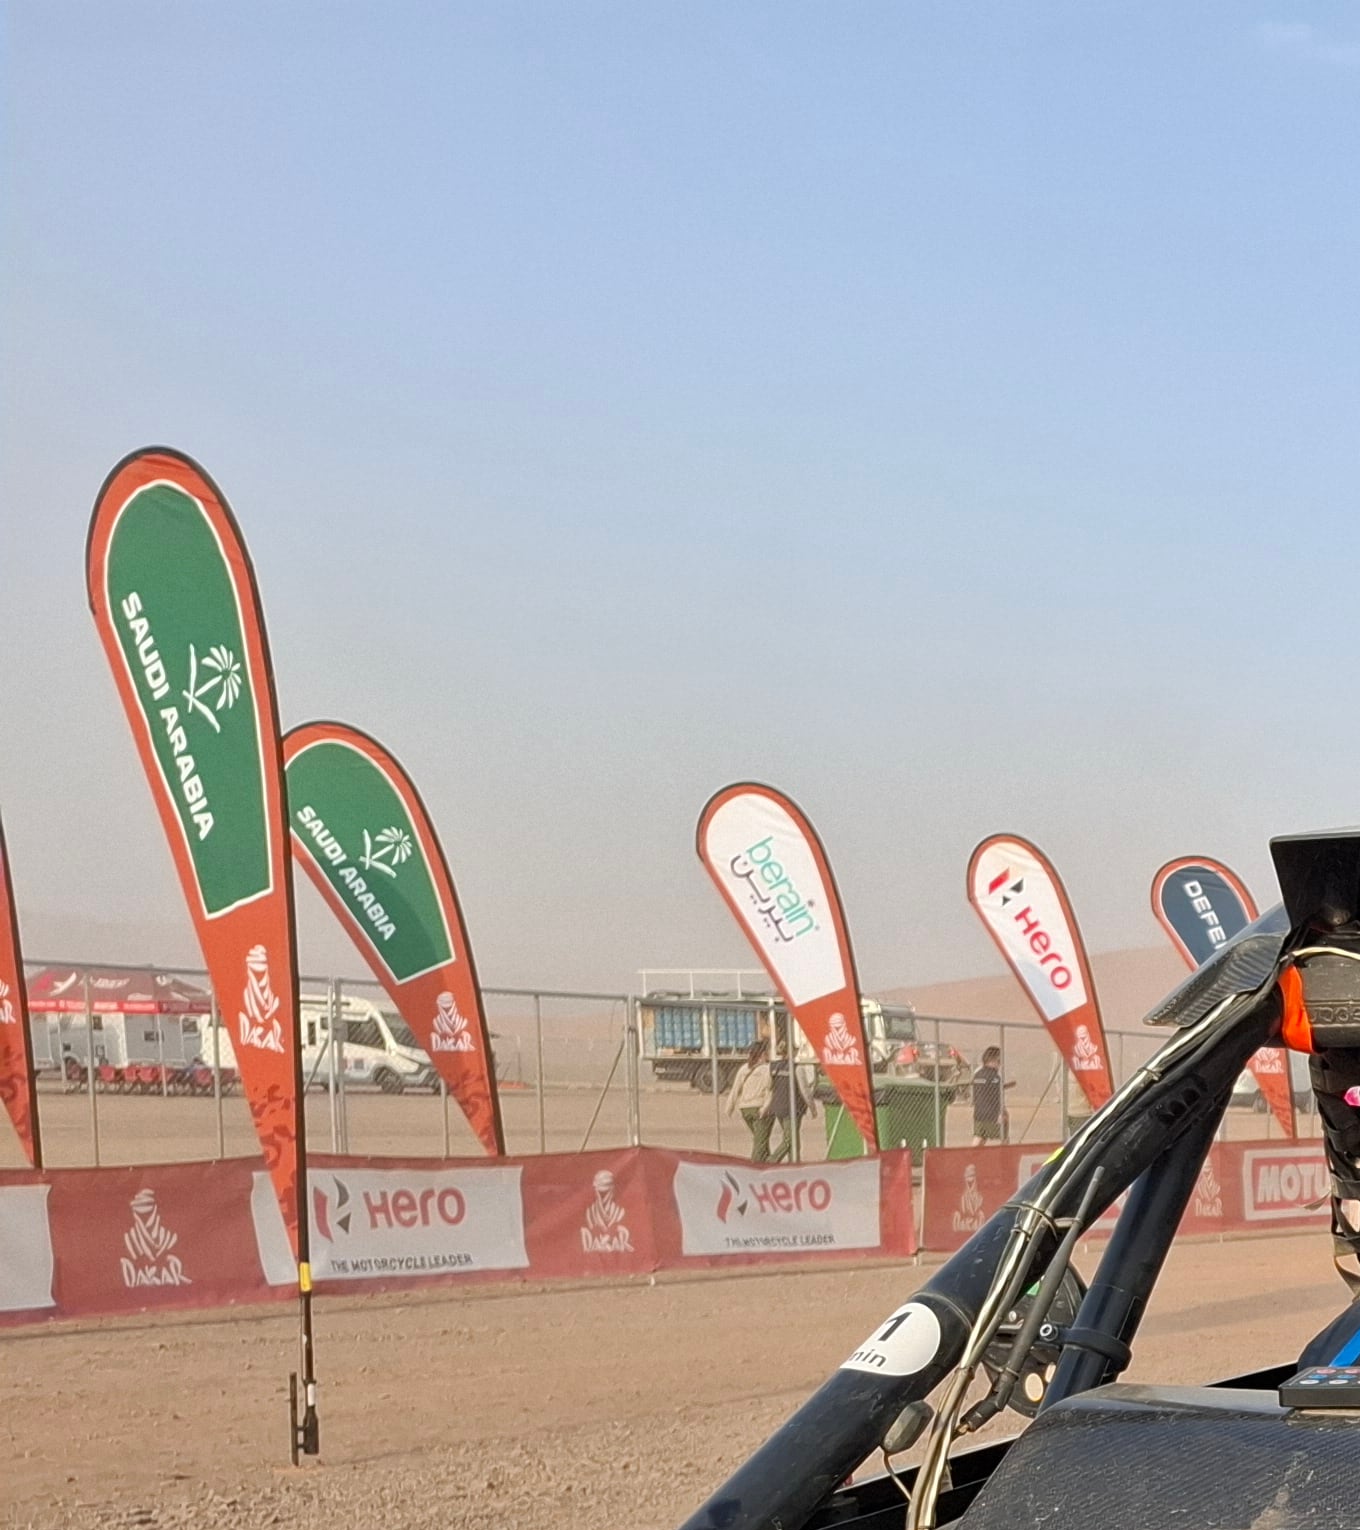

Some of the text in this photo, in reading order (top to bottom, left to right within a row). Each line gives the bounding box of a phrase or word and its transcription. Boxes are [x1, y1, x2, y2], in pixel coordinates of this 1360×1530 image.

[121, 590, 215, 841] SAUDI ARABIA
[297, 805, 396, 942] SAUDI ARABIA
[746, 836, 816, 938] berain
[1013, 906, 1072, 991] Hero
[239, 1013, 285, 1054] DAKAR
[430, 1030, 476, 1053] DAKAR
[823, 1047, 863, 1067] DAKAR
[1072, 1052, 1104, 1071] DAKAR
[1254, 1059, 1285, 1075] DAKAR
[748, 1177, 833, 1214] Hero
[1257, 1162, 1333, 1204] MOTU
[361, 1185, 467, 1230] Hero
[952, 1209, 985, 1234] DAKAR
[1195, 1198, 1223, 1217] DAKAR
[580, 1226, 635, 1255] DAKAR
[119, 1257, 193, 1289] DAKAR
[428, 1252, 473, 1270] LEADER
[877, 1310, 913, 1342] 1
